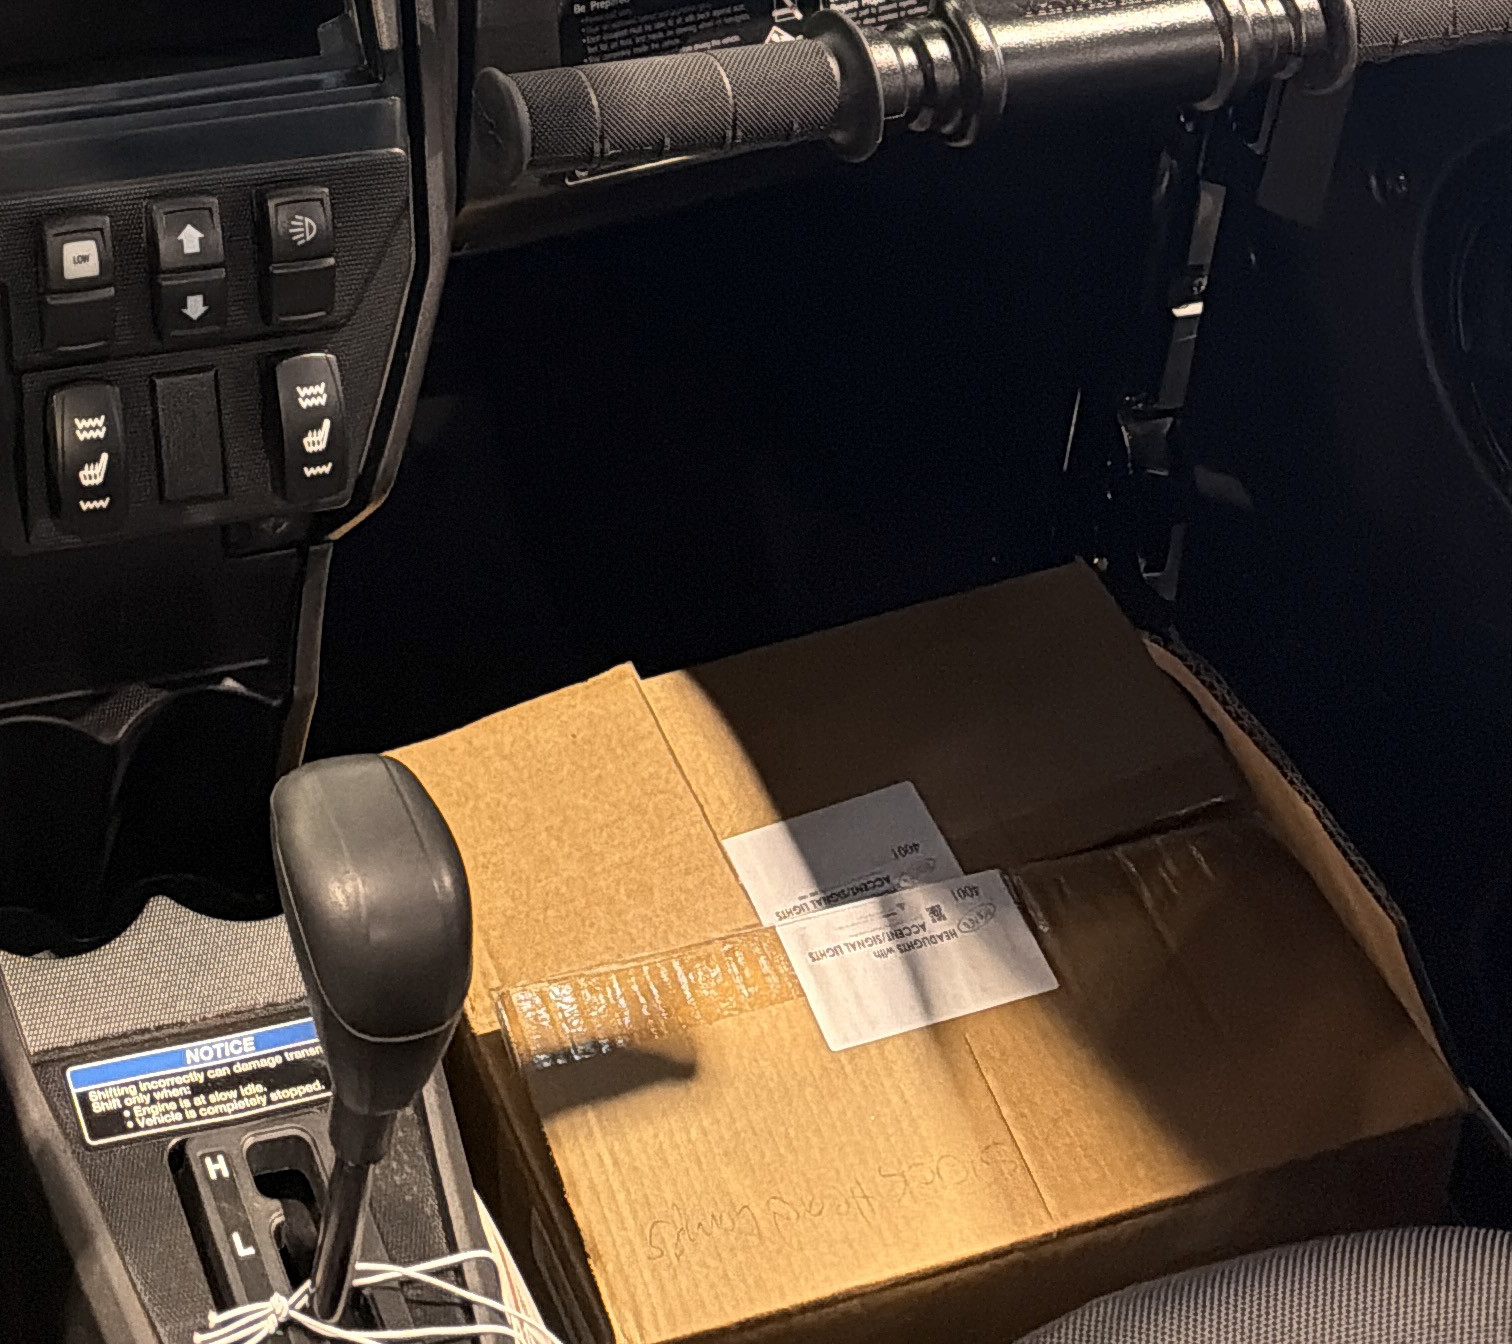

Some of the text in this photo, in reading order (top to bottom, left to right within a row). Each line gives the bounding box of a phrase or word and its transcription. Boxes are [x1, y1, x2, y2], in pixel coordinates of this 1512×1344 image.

[952, 885, 980, 902] 4001
[185, 1036, 256, 1064] NOTICE
[88, 1082, 138, 1103] Shifting
[206, 1066, 232, 1079] can
[233, 1054, 283, 1074] damage
[91, 1085, 192, 1114] Shift only when:
[133, 1101, 178, 1118] Engine
[179, 1097, 191, 1109] is
[193, 1094, 207, 1106] at
[208, 1088, 238, 1104] slow
[135, 1079, 326, 1130] Vehicle is completely stopped.
[204, 1154, 230, 1181] H
[231, 1231, 256, 1257] L
